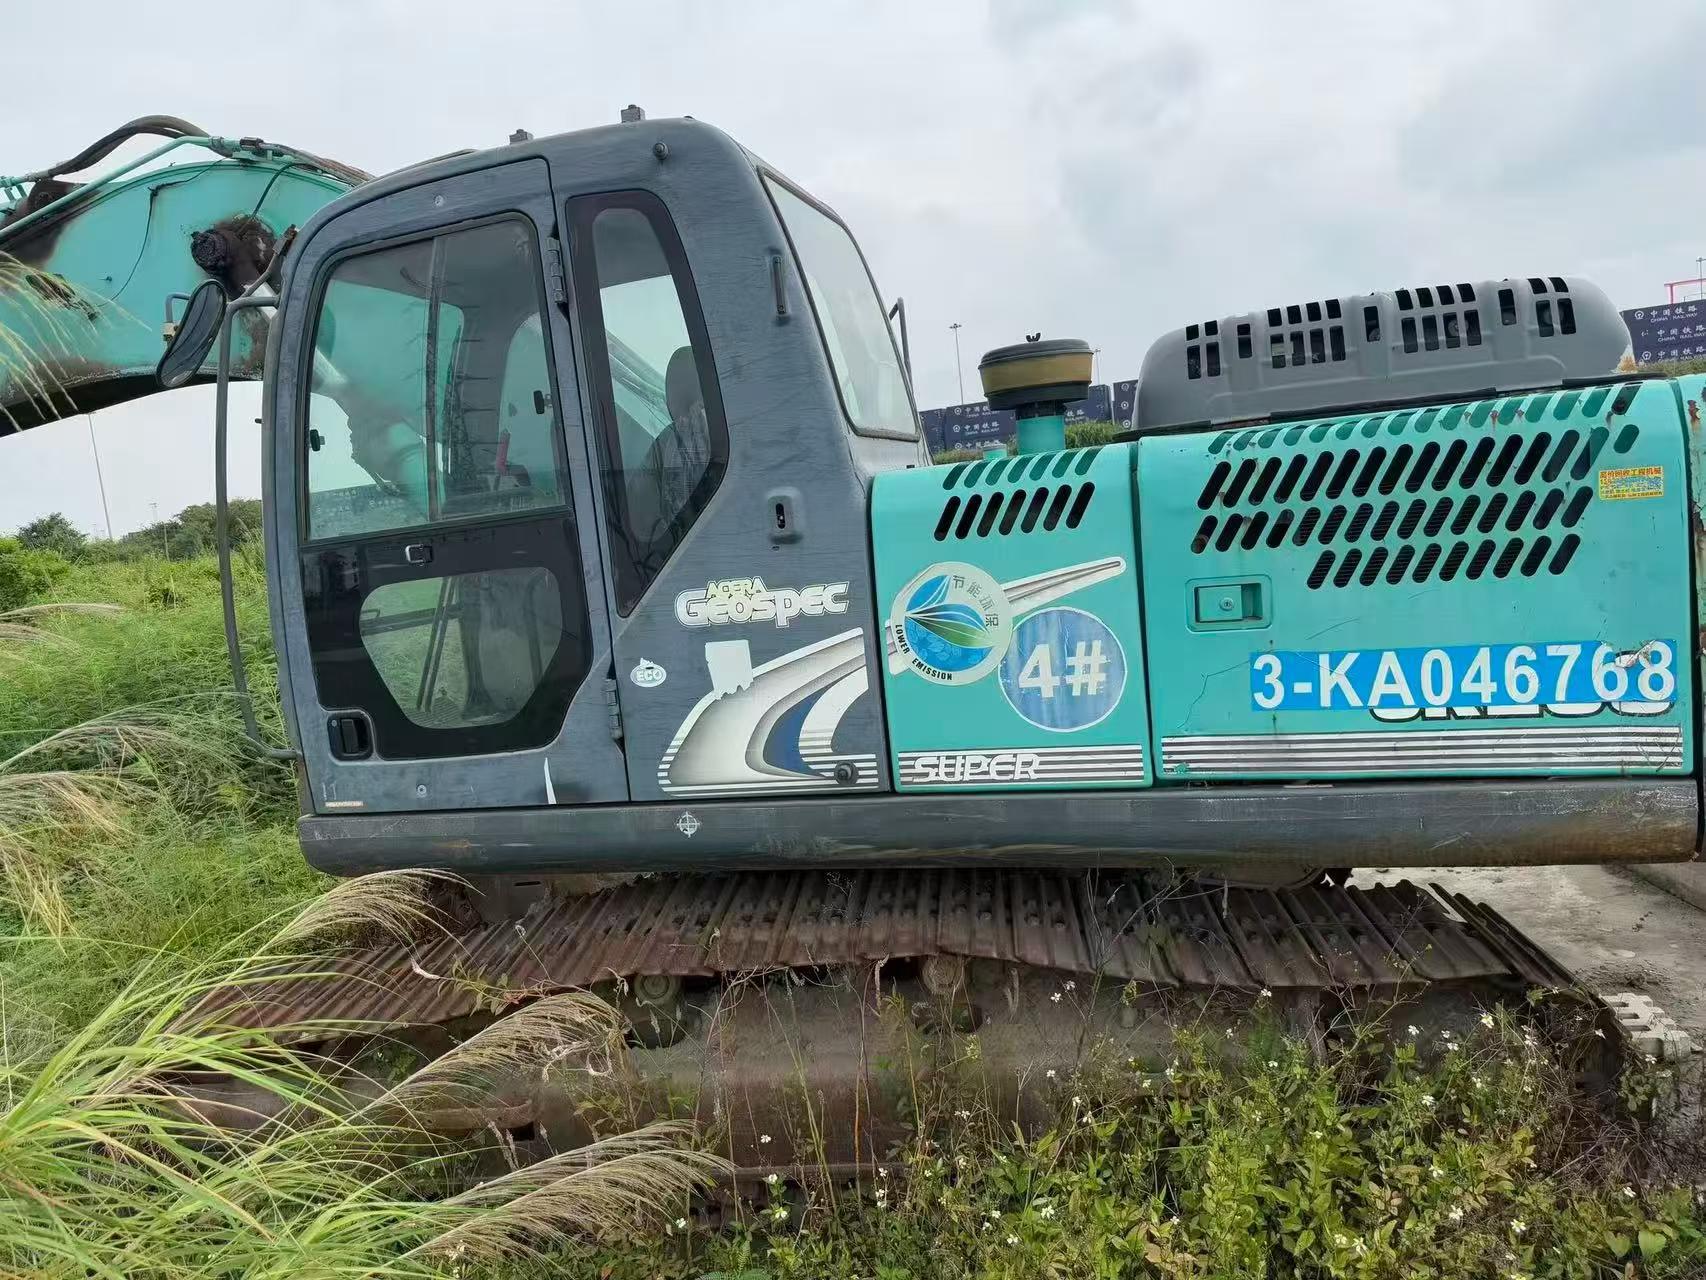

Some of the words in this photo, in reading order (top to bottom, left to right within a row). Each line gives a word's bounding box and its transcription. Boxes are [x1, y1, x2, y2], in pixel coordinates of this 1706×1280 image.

[1650, 305, 1698, 318] 中国铁路
[1657, 324, 1706, 338] 中国铁路
[1658, 346, 1706, 359] 中国铁路
[706, 576, 768, 599] ACERA
[953, 575, 999, 627] 节能环保
[895, 624, 911, 655] LOWER
[912, 658, 953, 681] EMISSION
[636, 669, 662, 682] ECO
[1018, 639, 1110, 698] 4#
[1253, 640, 1675, 709] 3-KA046768
[912, 752, 1041, 783] SUPER
